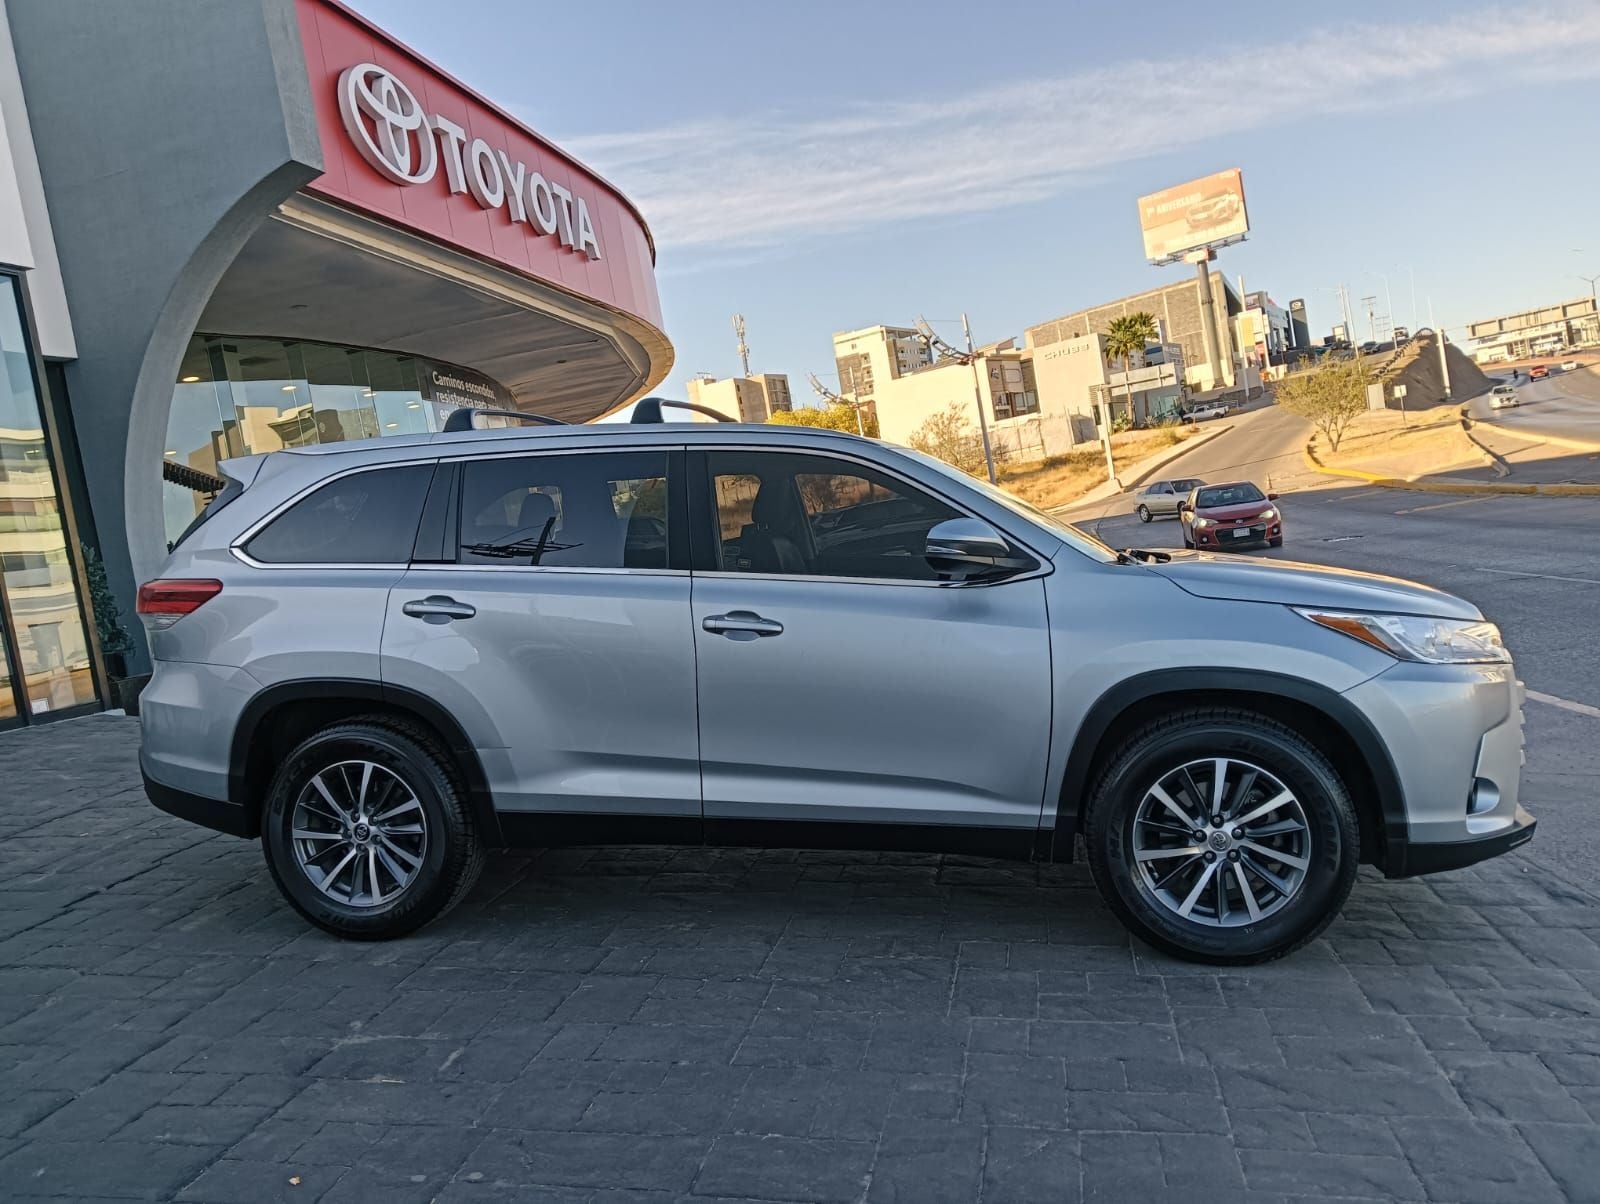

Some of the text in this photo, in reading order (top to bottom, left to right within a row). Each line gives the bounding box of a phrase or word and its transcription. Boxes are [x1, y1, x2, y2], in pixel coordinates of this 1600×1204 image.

[431, 114, 602, 260] TOYOTA
[432, 371, 465, 390] Caminos
[436, 390, 474, 408] resistencia
